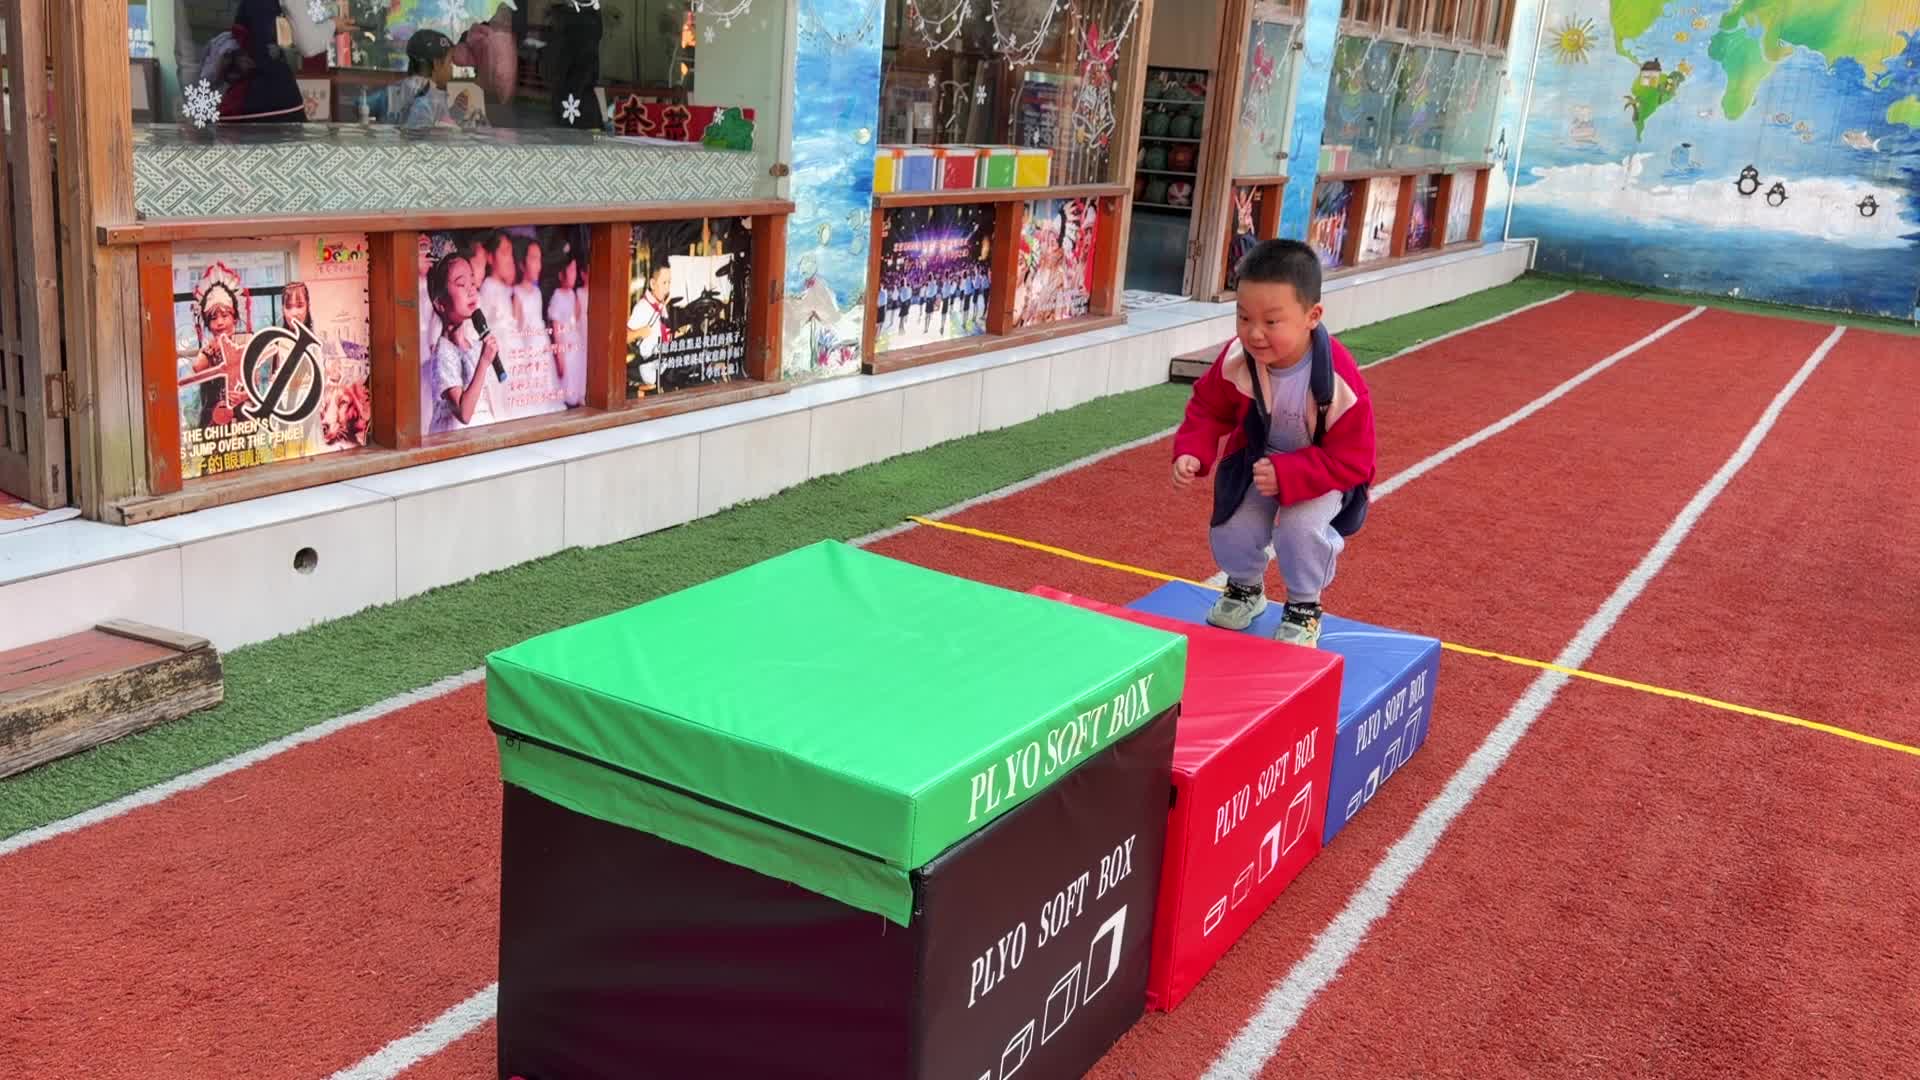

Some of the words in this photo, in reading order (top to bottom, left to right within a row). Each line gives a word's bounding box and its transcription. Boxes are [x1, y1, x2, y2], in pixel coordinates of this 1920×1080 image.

[182, 428, 202, 443] THE
[189, 440, 217, 458] JUMP
[218, 437, 246, 453] OVER
[247, 432, 266, 448] THE
[968, 741, 1040, 823] PLYO
[1045, 703, 1108, 776] SOFT
[1107, 673, 1154, 739] BOX
[1355, 709, 1381, 756] PLYO
[1384, 688, 1407, 730] SOFT
[1408, 669, 1427, 709] BOX
[1214, 784, 1250, 845] PLYO
[1256, 751, 1289, 806] SOFT
[1294, 727, 1318, 775] BOX
[968, 921, 1027, 1009] PLYO
[1038, 871, 1089, 948] SOFT
[1096, 834, 1136, 900] BOX
